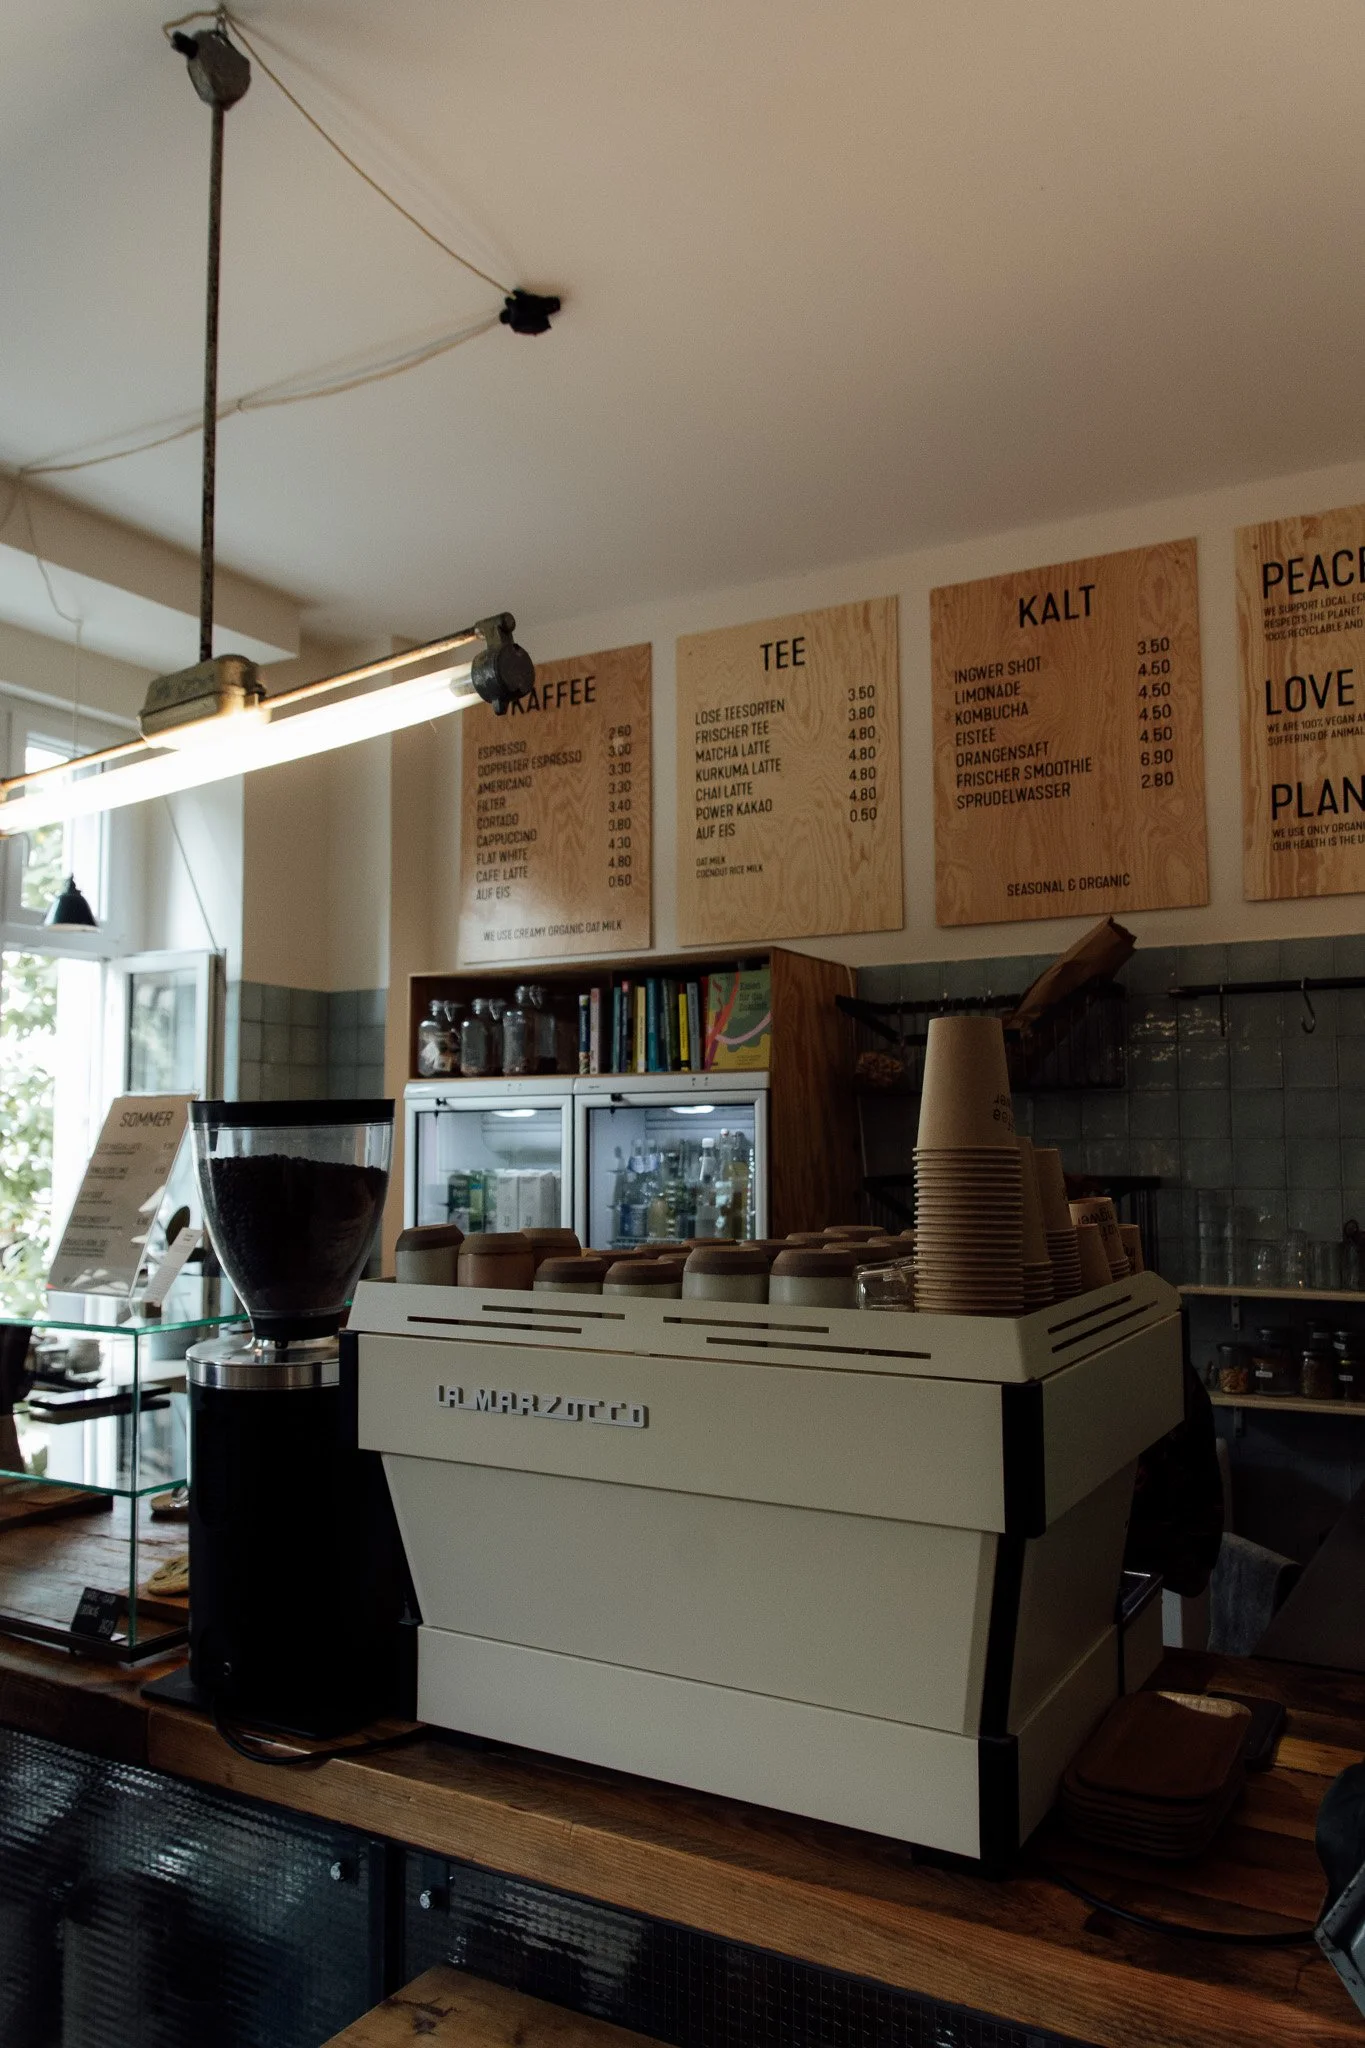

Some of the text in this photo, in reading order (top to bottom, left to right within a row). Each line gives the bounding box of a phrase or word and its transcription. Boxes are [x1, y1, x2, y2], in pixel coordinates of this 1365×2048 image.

[1019, 585, 1095, 628] KALT
[760, 637, 806, 671] TEE
[954, 638, 1170, 684] INGWER SHOT 3.50
[512, 676, 596, 716] KAFFEE
[955, 660, 1170, 705] LIMONADE 4.50
[696, 686, 874, 726] LOSE TEESORTEN 3.50
[955, 683, 1171, 726] KOMBUCHA 4.50
[696, 706, 875, 743] FRISCHER TEE 3.80
[956, 705, 1171, 746] EISTEE 4.50
[696, 726, 875, 763] MATCHA LATTE 4.80
[956, 727, 1172, 767] ORANGENSAFT 4.50
[696, 747, 876, 782] KURKUMA LATTE 4.80
[957, 750, 1173, 788] FRISCHER SMOOTHIE 6.90
[696, 767, 876, 802] CHAI LATTE 4.80
[957, 772, 1174, 809] SPRUDELWASSER 2.80
[696, 788, 876, 821] POWER KAKAO 4.80
[696, 808, 877, 840] AUF EIS 0.50
[709, 856, 725, 865] MILK
[746, 864, 763, 873] MILK
[1007, 879, 1064, 897] SEASONAL
[1079, 874, 1130, 890] ORGANIC
[120, 1111, 174, 1127] SOMMER
